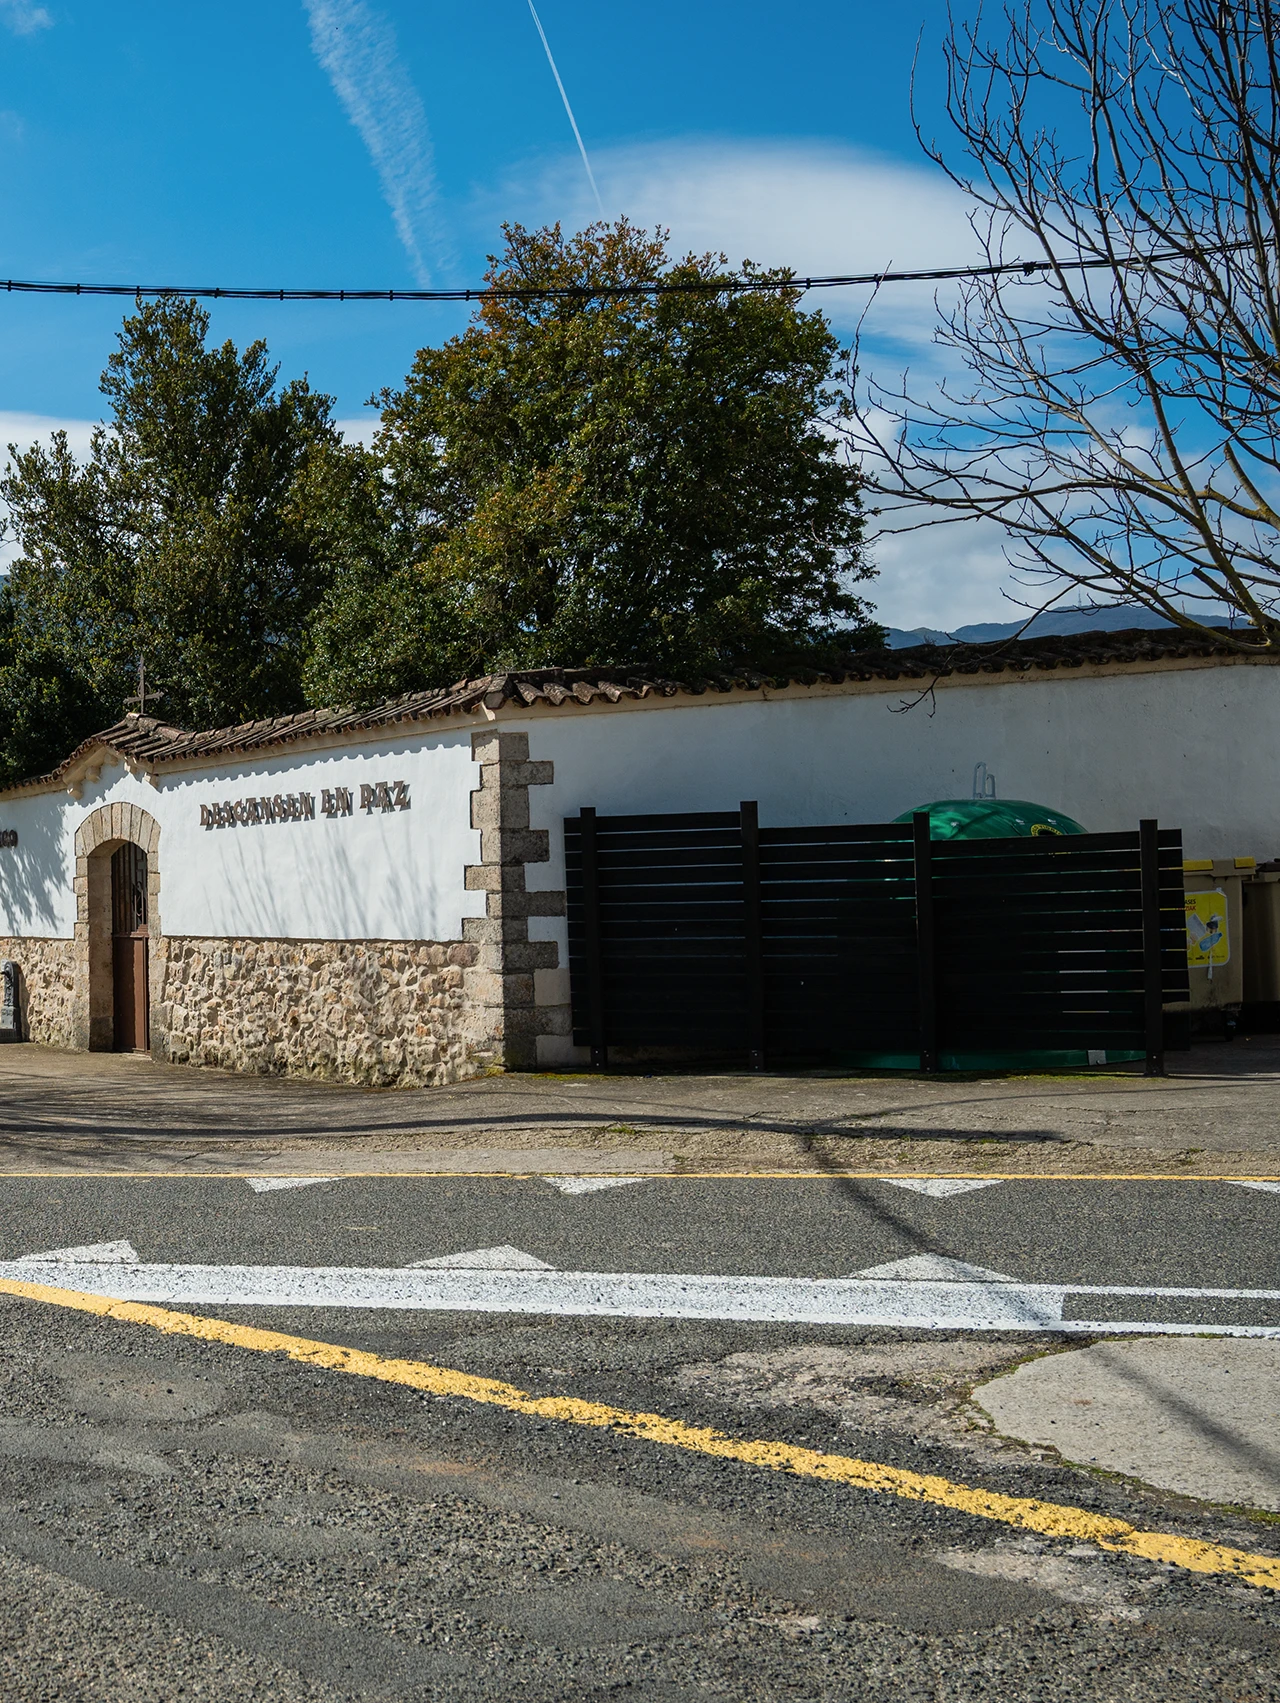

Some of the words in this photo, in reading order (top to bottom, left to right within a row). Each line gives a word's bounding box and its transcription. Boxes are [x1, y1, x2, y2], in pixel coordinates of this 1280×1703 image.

[199, 791, 312, 827] DESCANSEN
[320, 786, 350, 814] EN
[359, 780, 409, 810] PAZ
